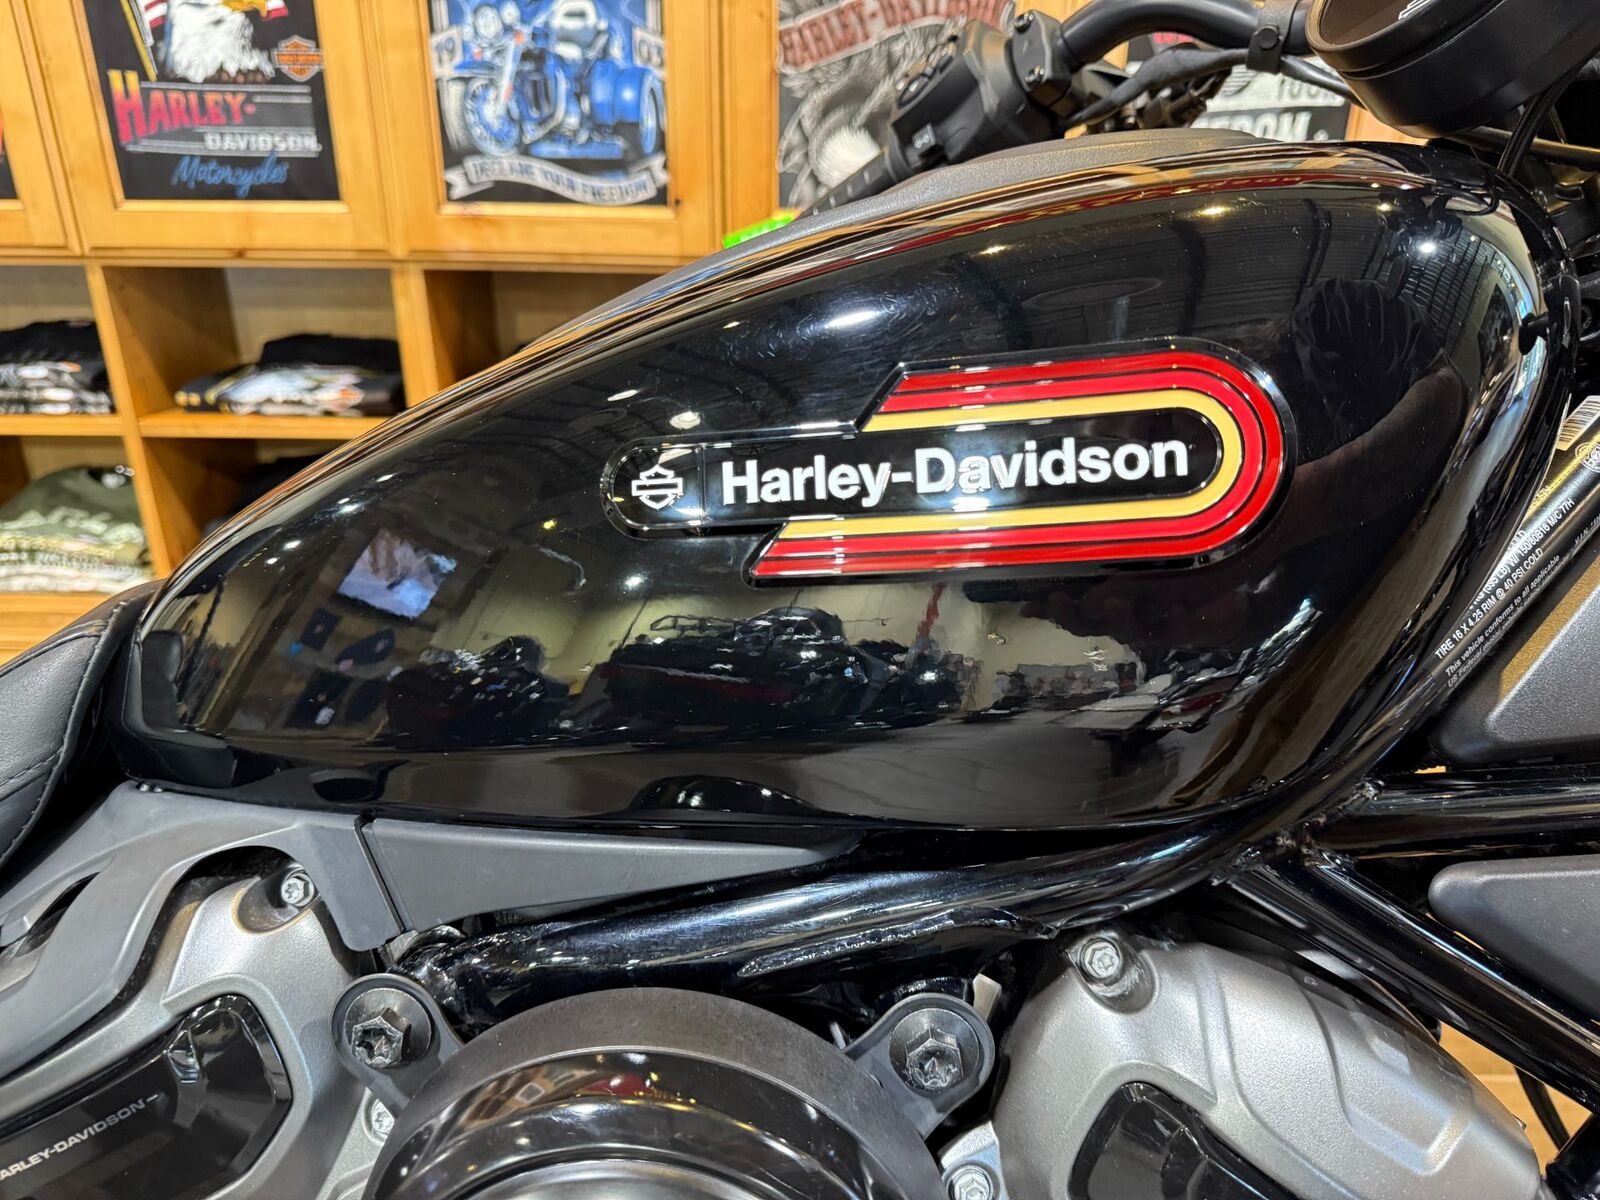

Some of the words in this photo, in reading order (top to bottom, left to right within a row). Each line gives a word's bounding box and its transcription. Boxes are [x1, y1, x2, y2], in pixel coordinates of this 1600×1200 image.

[721, 437, 1189, 507] Harley-Davidson
[1435, 638, 1455, 659] TIRE
[1452, 630, 1463, 641] 16
[1460, 623, 1470, 634] X
[1468, 609, 1483, 626] 4.25
[1481, 595, 1497, 613] RIM
[1504, 578, 1513, 590] 40
[1511, 566, 1525, 582] PSI
[1523, 548, 1543, 570] COLD
[1445, 660, 1461, 676] This
[1461, 635, 1484, 660] vehicle
[1485, 604, 1514, 637] conforms
[1514, 596, 1521, 605] to
[1522, 585, 1530, 598] all
[1530, 555, 1559, 589] applicable
[0, 1098, 146, 1181] ARLEY-DAVIDSON
